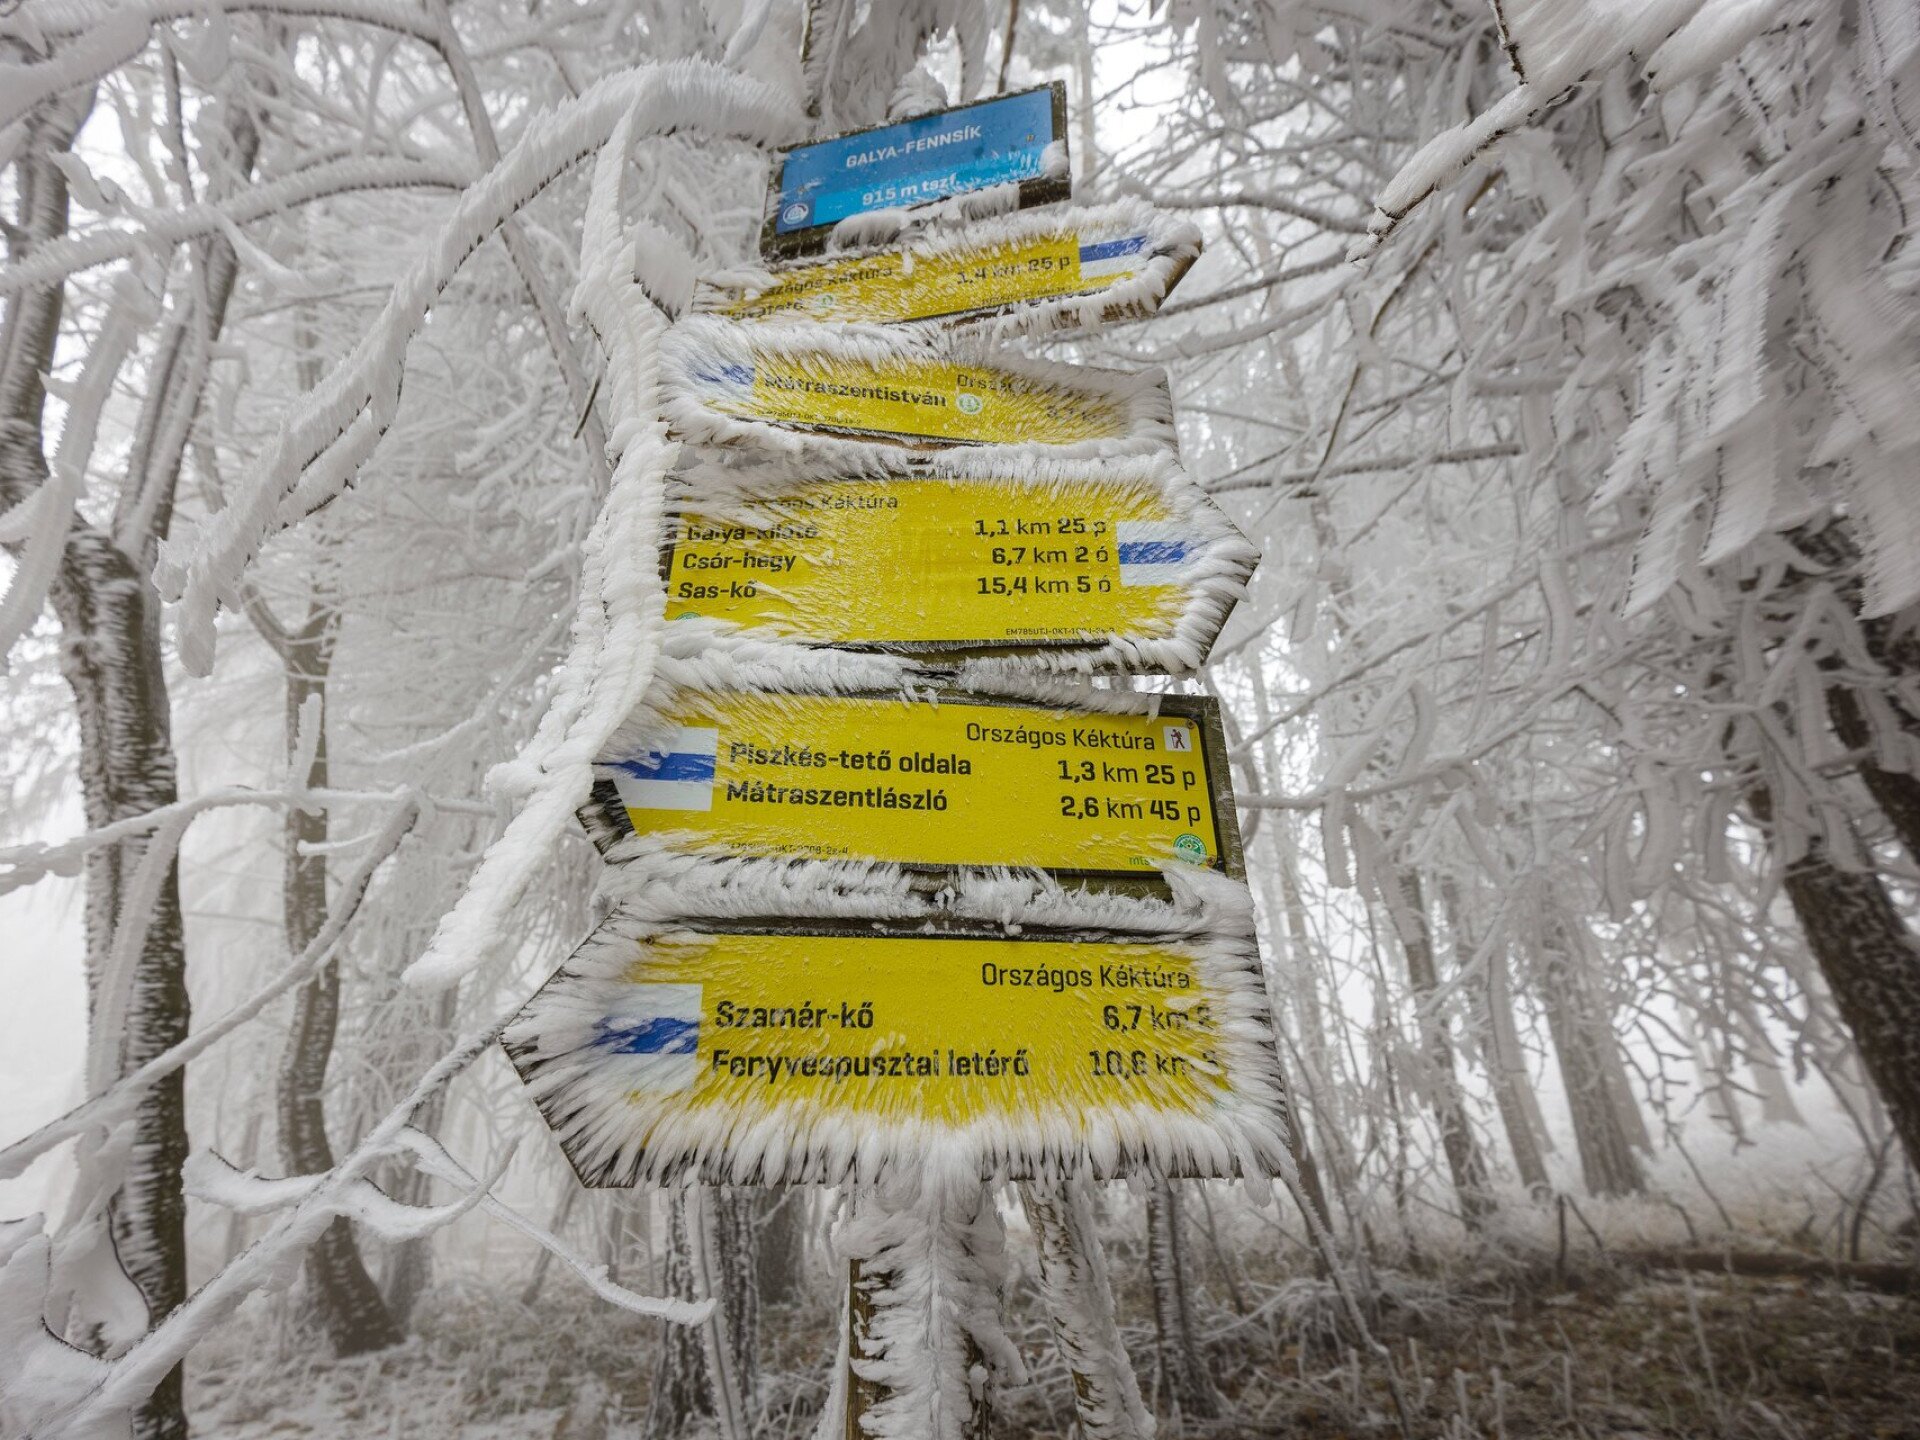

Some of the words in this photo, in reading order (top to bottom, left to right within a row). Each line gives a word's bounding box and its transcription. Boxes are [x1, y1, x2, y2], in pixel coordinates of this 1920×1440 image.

[846, 125, 982, 169] GALYA-FENNSÍK
[862, 187, 897, 206] 915
[901, 184, 917, 199] m
[957, 268, 986, 285] 1,4
[1028, 257, 1052, 272] 25
[1059, 256, 1071, 271] p
[764, 375, 947, 408] Mátraszentistván
[975, 519, 1009, 538] 1,1
[1017, 518, 1050, 535] km
[1057, 517, 1086, 535] 25
[682, 551, 797, 573] Csór-hegy
[992, 547, 1027, 566] 6,7
[1033, 546, 1068, 564] km
[1075, 546, 1090, 563] 2
[1096, 544, 1109, 562] ó
[977, 576, 1028, 597] 15,4
[1035, 576, 1069, 594] km
[1077, 575, 1091, 593] 5
[1098, 574, 1111, 593] ó
[966, 722, 1066, 750] Országos
[1073, 728, 1155, 751] Kéktúra
[729, 742, 892, 772] Piszkés-tető
[899, 752, 972, 776] oldala
[1057, 759, 1096, 784] 1,3
[1103, 761, 1138, 784] km
[1145, 764, 1175, 785] 25
[1182, 769, 1196, 791] p
[726, 780, 948, 812] Mátraszentlászló
[1060, 795, 1099, 820] 2,6
[1106, 797, 1143, 820] km
[1150, 799, 1180, 821] 45
[1187, 804, 1201, 827] p
[982, 962, 1093, 993] Országos
[1100, 965, 1190, 989] Kéktúra
[715, 1001, 875, 1030] Szamár-kő
[1103, 1004, 1142, 1034] 6,7
[1151, 1005, 1189, 1031] km
[712, 1049, 940, 1085] Fenyvespusztai
[948, 1049, 1029, 1077] letérő
